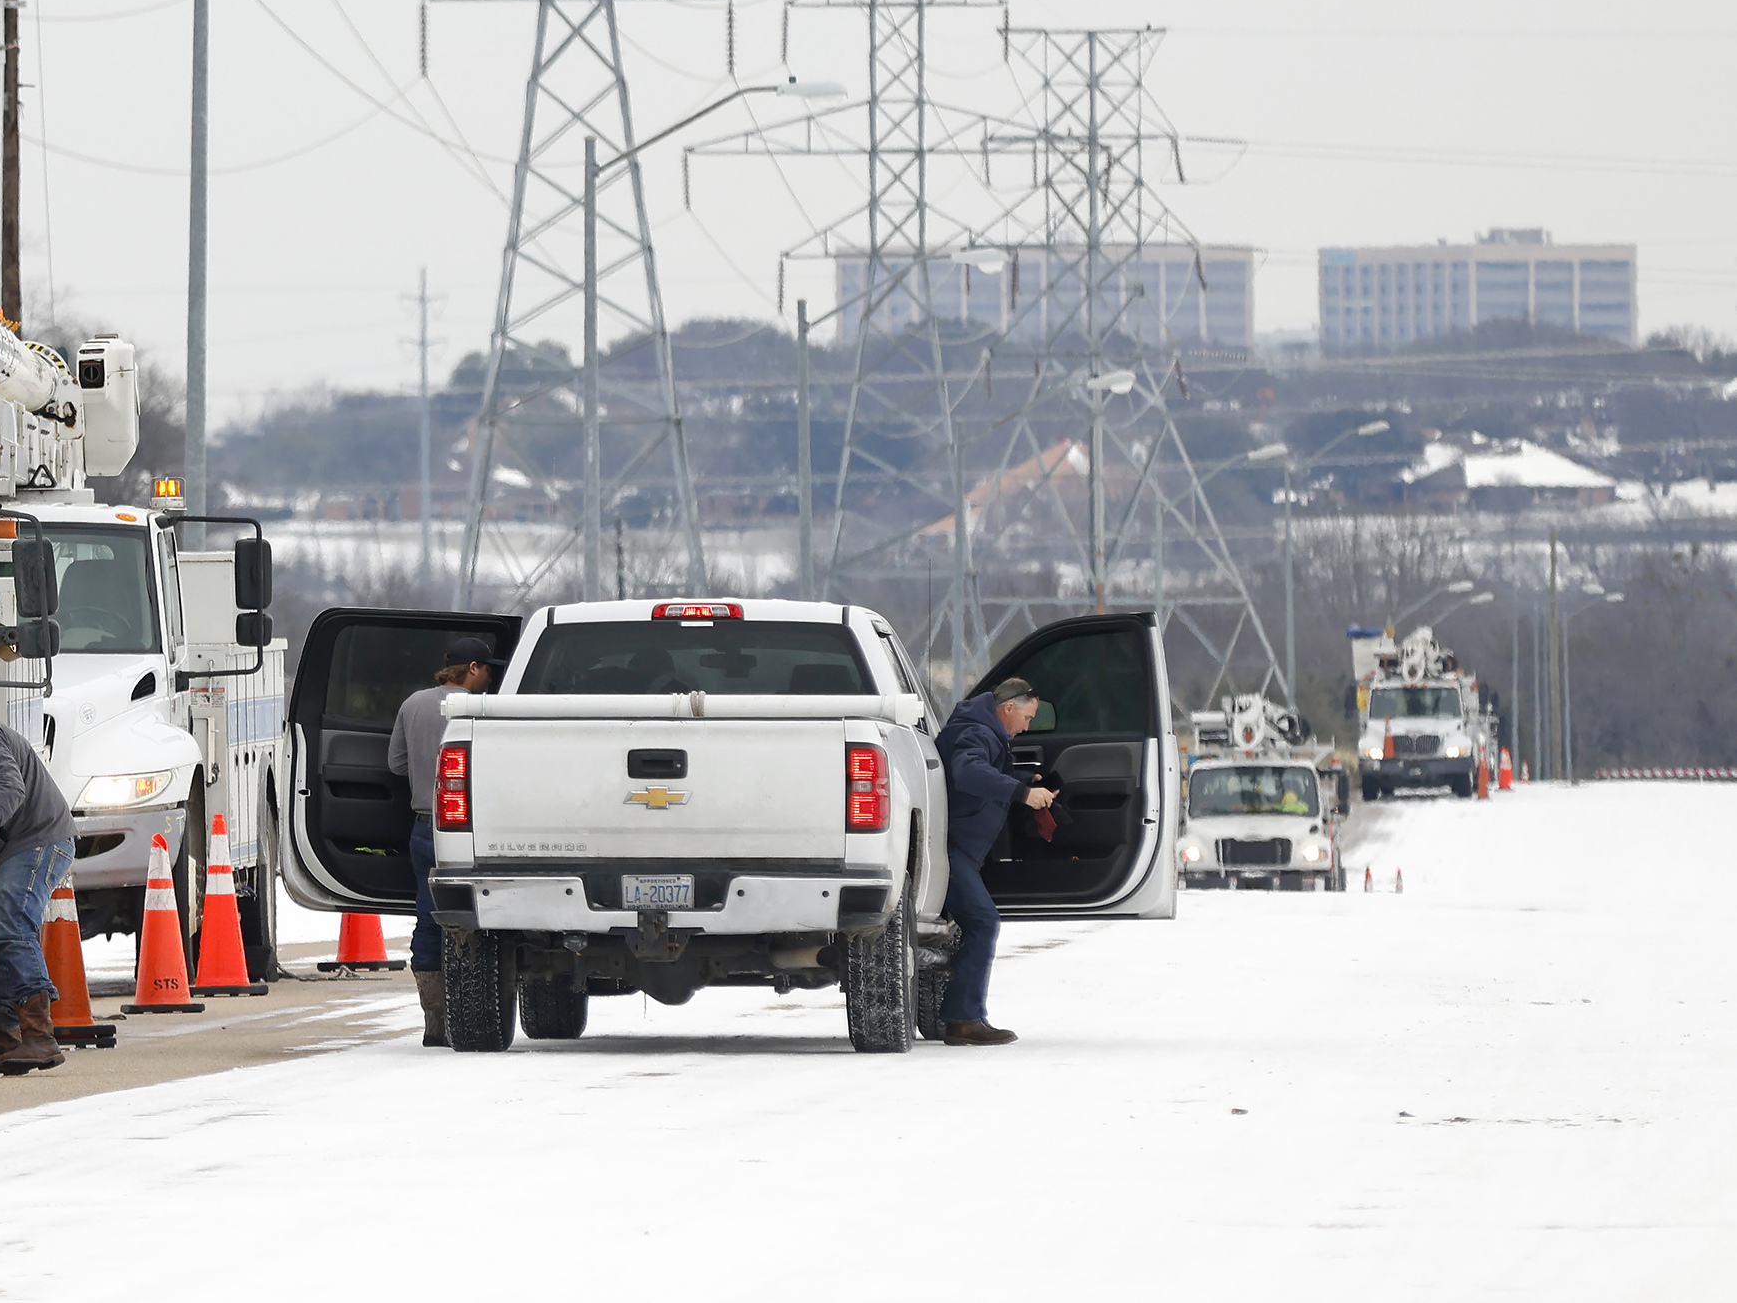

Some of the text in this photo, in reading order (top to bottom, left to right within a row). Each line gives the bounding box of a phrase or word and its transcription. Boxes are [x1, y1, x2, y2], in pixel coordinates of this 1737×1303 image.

[488, 843, 587, 852] SILVERADO
[625, 885, 690, 903] LA-20377
[153, 978, 179, 991] STS
